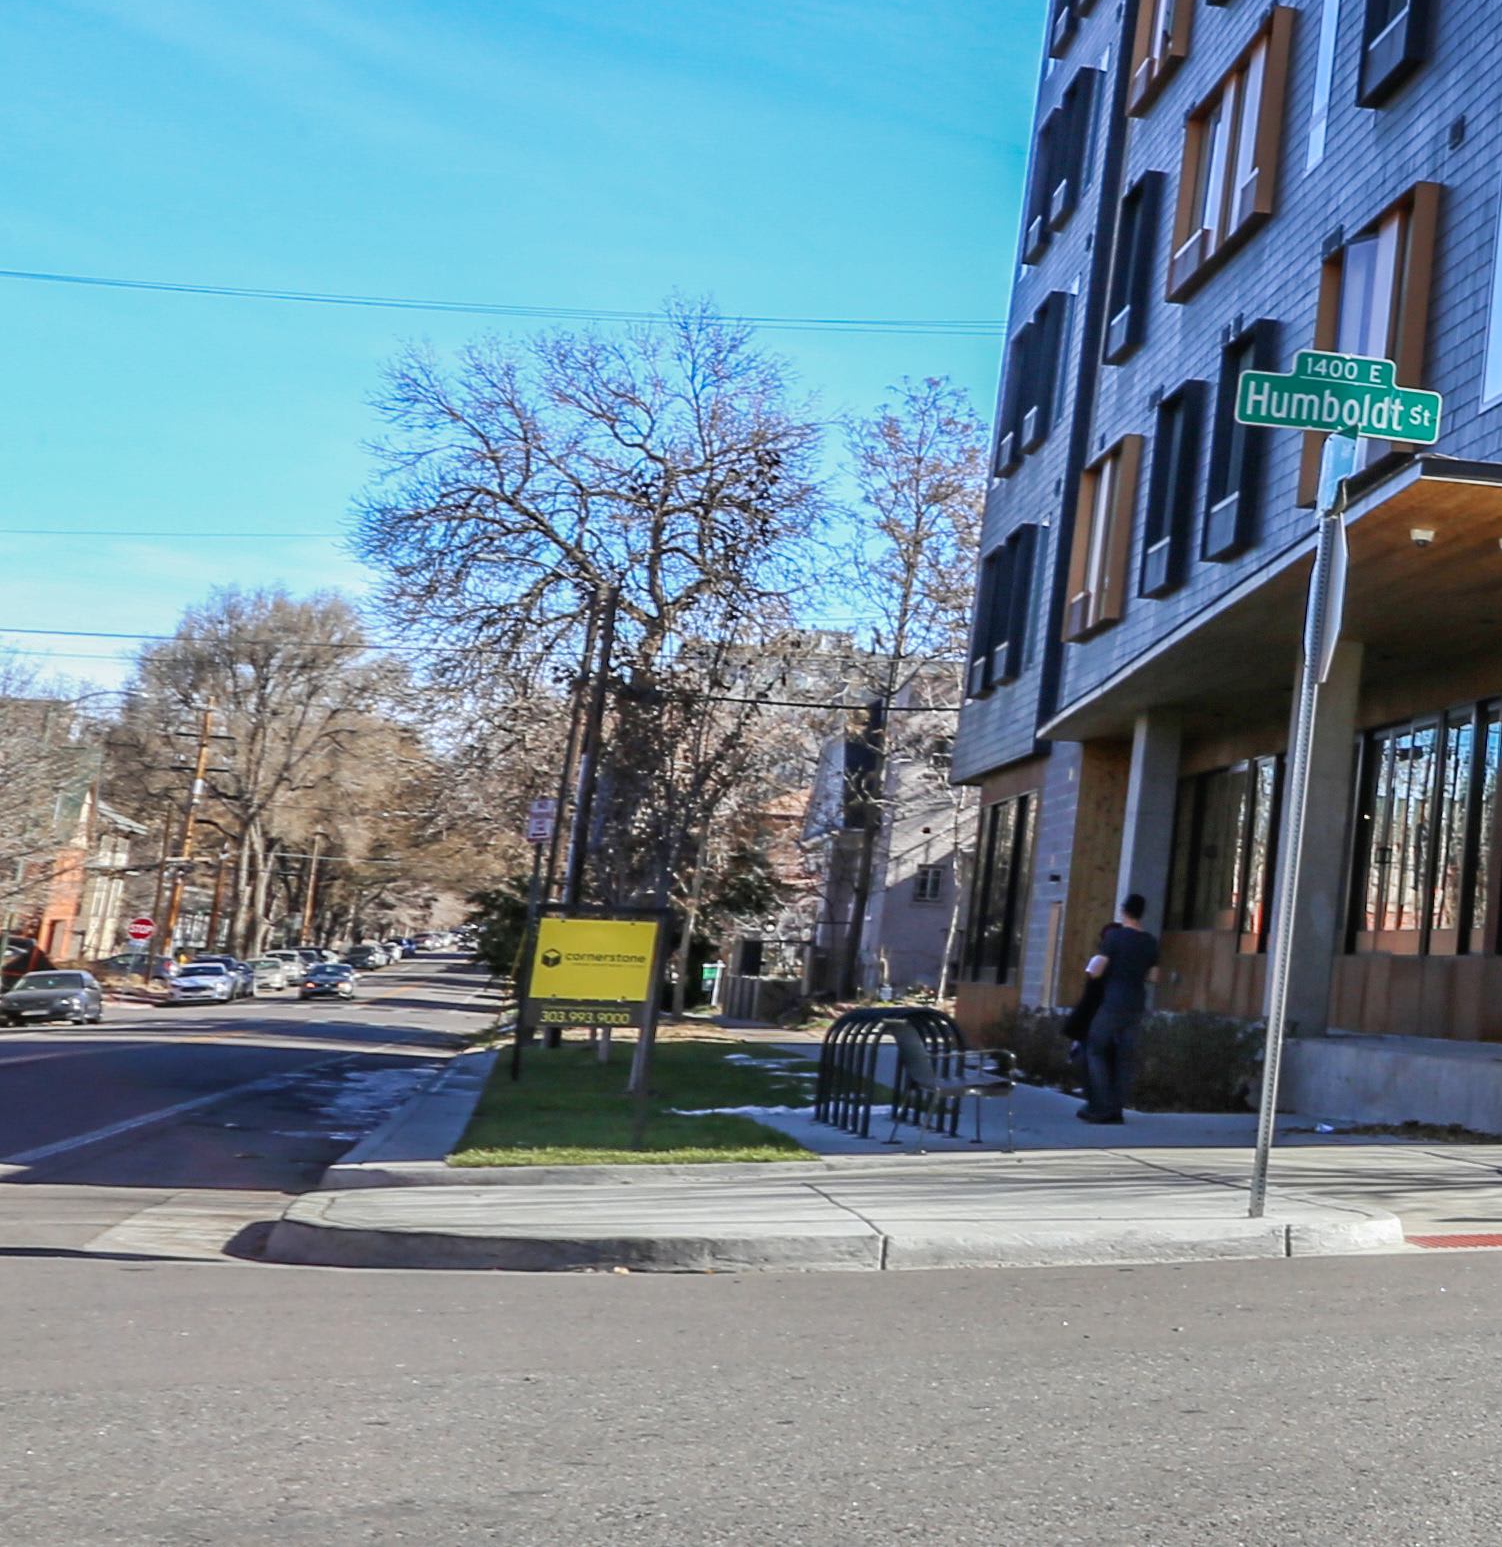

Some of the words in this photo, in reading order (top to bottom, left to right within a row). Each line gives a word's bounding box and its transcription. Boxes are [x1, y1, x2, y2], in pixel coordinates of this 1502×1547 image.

[1306, 357, 1358, 380] 1400
[1369, 364, 1383, 383] E
[1246, 380, 1404, 431] Humboldt
[1409, 404, 1432, 427] St
[565, 952, 647, 964] cornerstone
[540, 1010, 630, 1025] 303.993.9000
